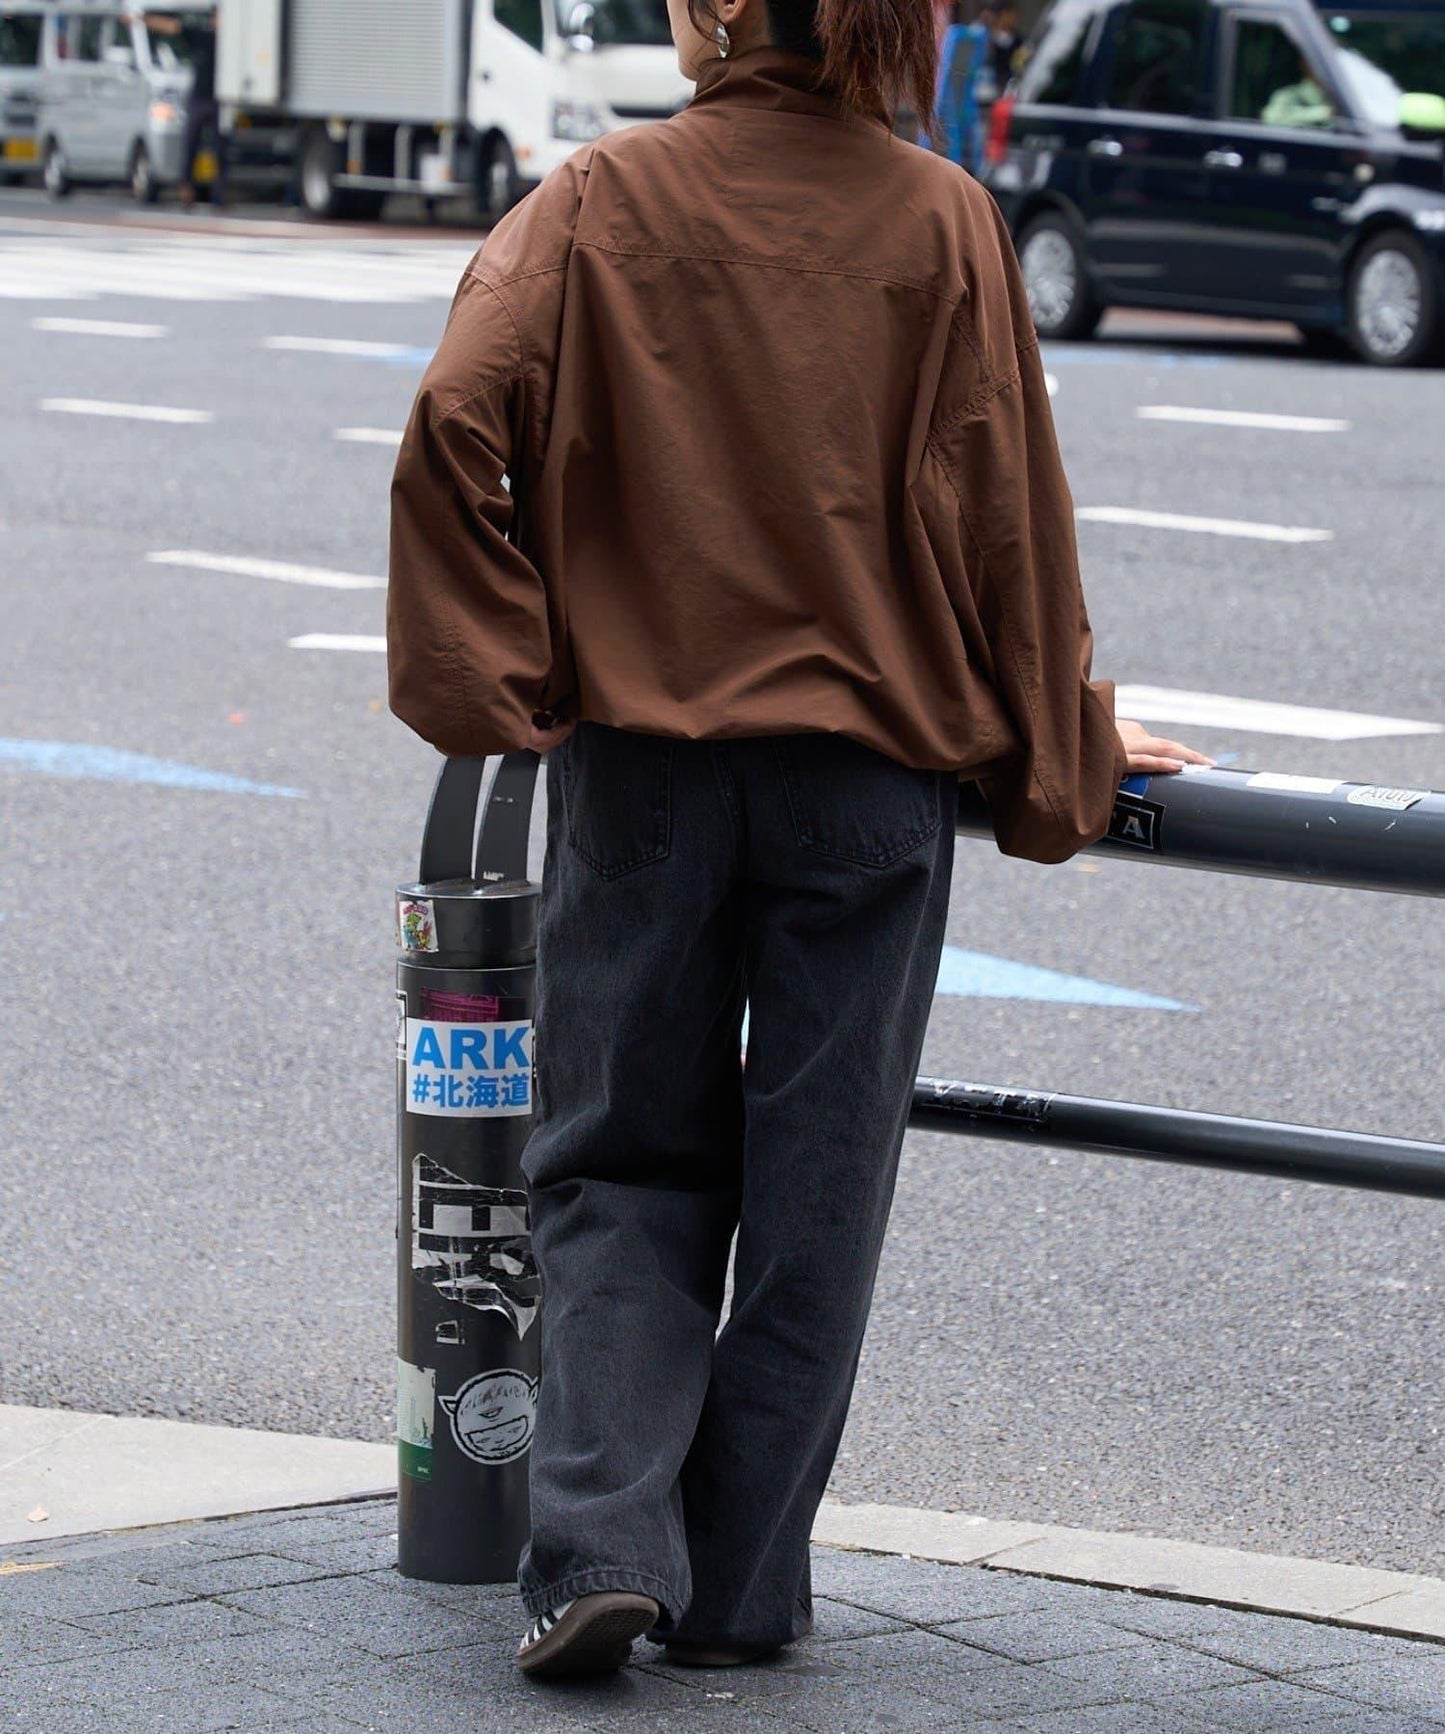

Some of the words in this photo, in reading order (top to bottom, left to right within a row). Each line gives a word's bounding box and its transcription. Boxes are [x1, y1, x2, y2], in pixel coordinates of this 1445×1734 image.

[412, 1026, 530, 1070] ARK
[412, 1073, 530, 1108] #北海道
